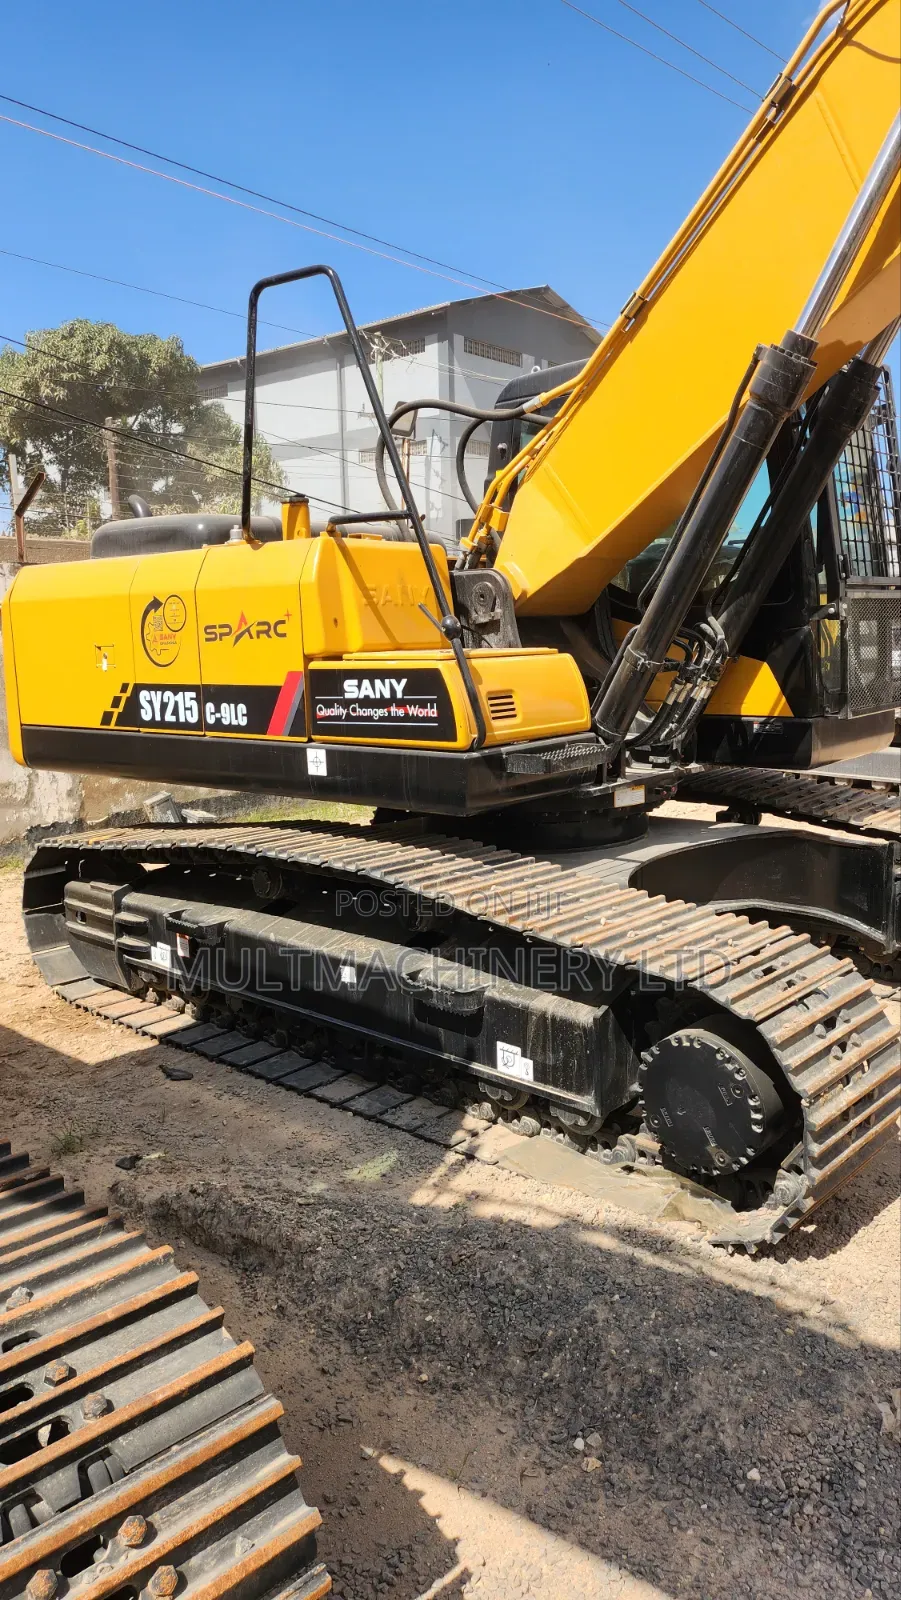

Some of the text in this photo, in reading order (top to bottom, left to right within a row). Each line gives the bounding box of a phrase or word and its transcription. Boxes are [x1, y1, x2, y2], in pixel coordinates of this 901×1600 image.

[203, 609, 288, 649] SPARC
[343, 678, 408, 699] SANY
[138, 689, 248, 727] SY215 C-9LC
[316, 702, 438, 720] Quality Changes the World
